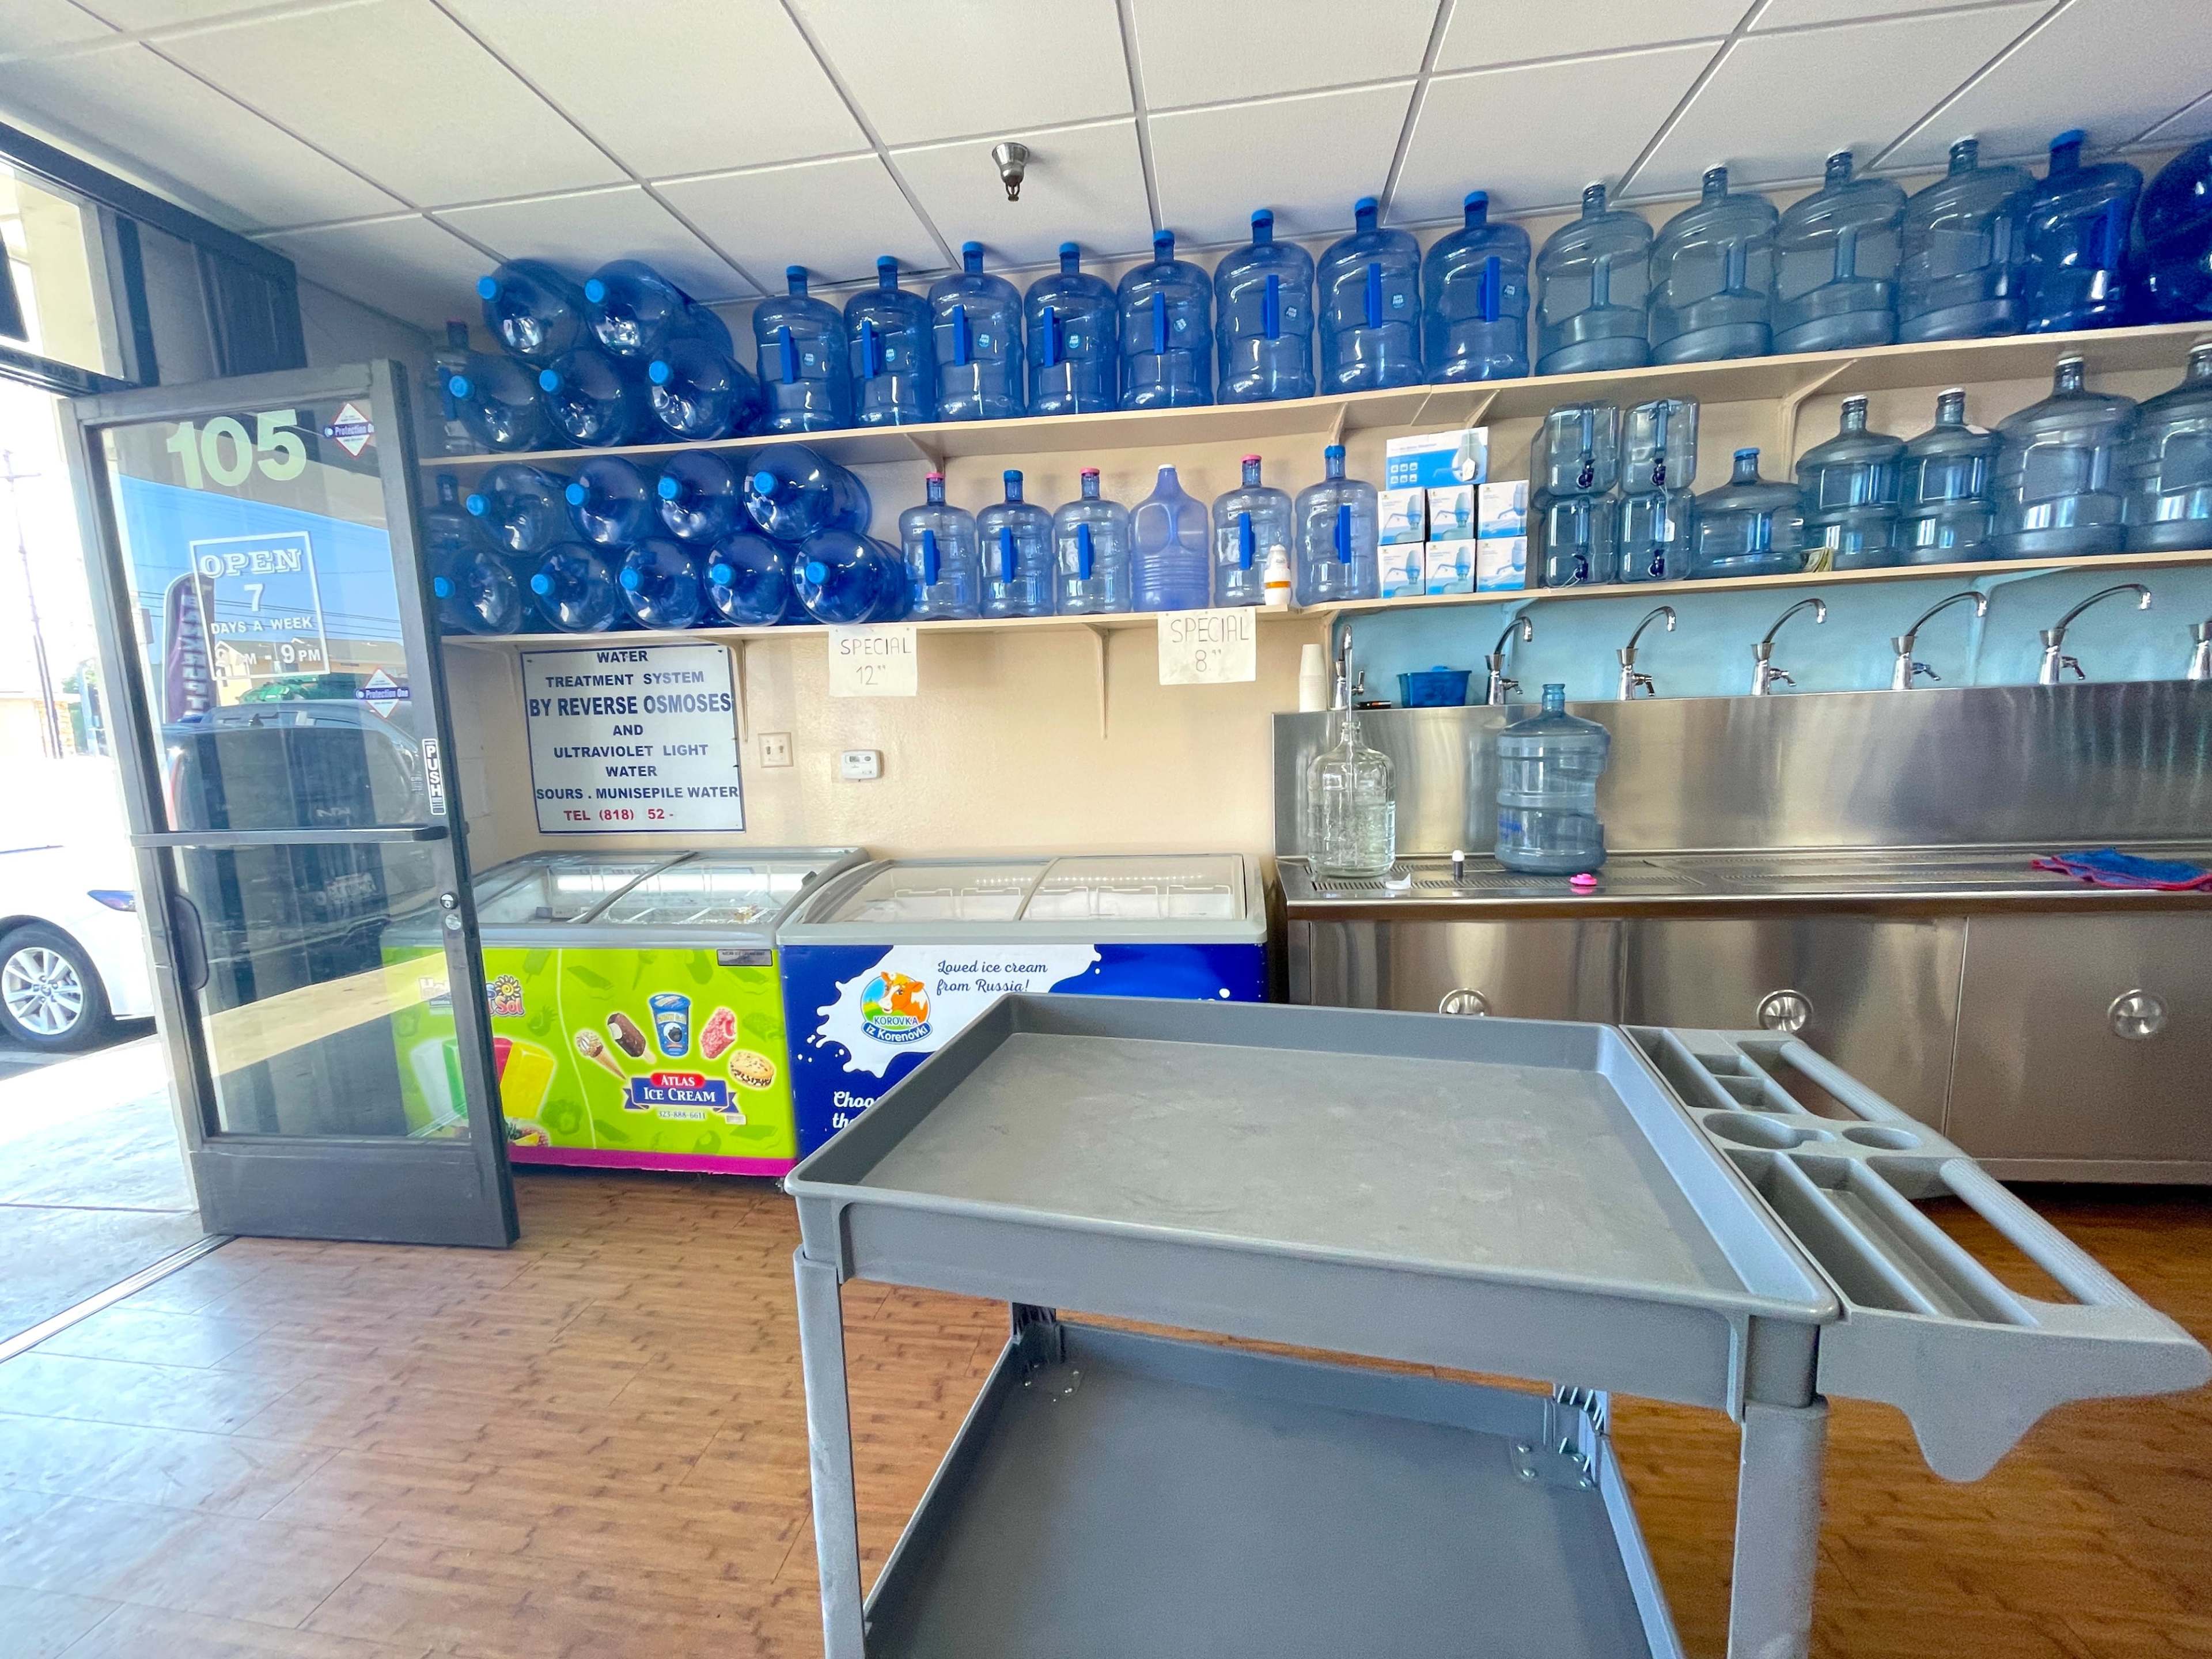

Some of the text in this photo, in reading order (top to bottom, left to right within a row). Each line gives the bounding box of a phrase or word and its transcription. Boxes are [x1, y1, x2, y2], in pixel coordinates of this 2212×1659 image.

[166, 409, 306, 488] 105
[200, 548, 303, 578] OPEN
[244, 584, 264, 612] 7
[211, 617, 313, 634] DAYS A WEEK
[1171, 615, 1249, 642] SPECIAL
[281, 644, 295, 664] 9
[298, 649, 321, 662] PM
[840, 637, 911, 655] SPECIAL
[597, 650, 648, 663] WATER
[546, 671, 704, 688] TREATMENT SYSTEM
[529, 693, 732, 717] BY REVERSE OSMOSES
[613, 725, 643, 736] AND
[554, 744, 709, 758] ULTRAVIOLET LIGHT
[426, 745, 442, 796] PUSH
[605, 766, 657, 777] WATER
[537, 788, 583, 800] SOURS
[596, 787, 683, 799] MUNISEPILE
[688, 786, 739, 798] WATER
[564, 810, 590, 821] TEL
[599, 809, 634, 821] (818)
[937, 960, 1048, 973] Loved ice cream
[937, 979, 1029, 996] from Russia!
[874, 1017, 918, 1025] KOROVKA
